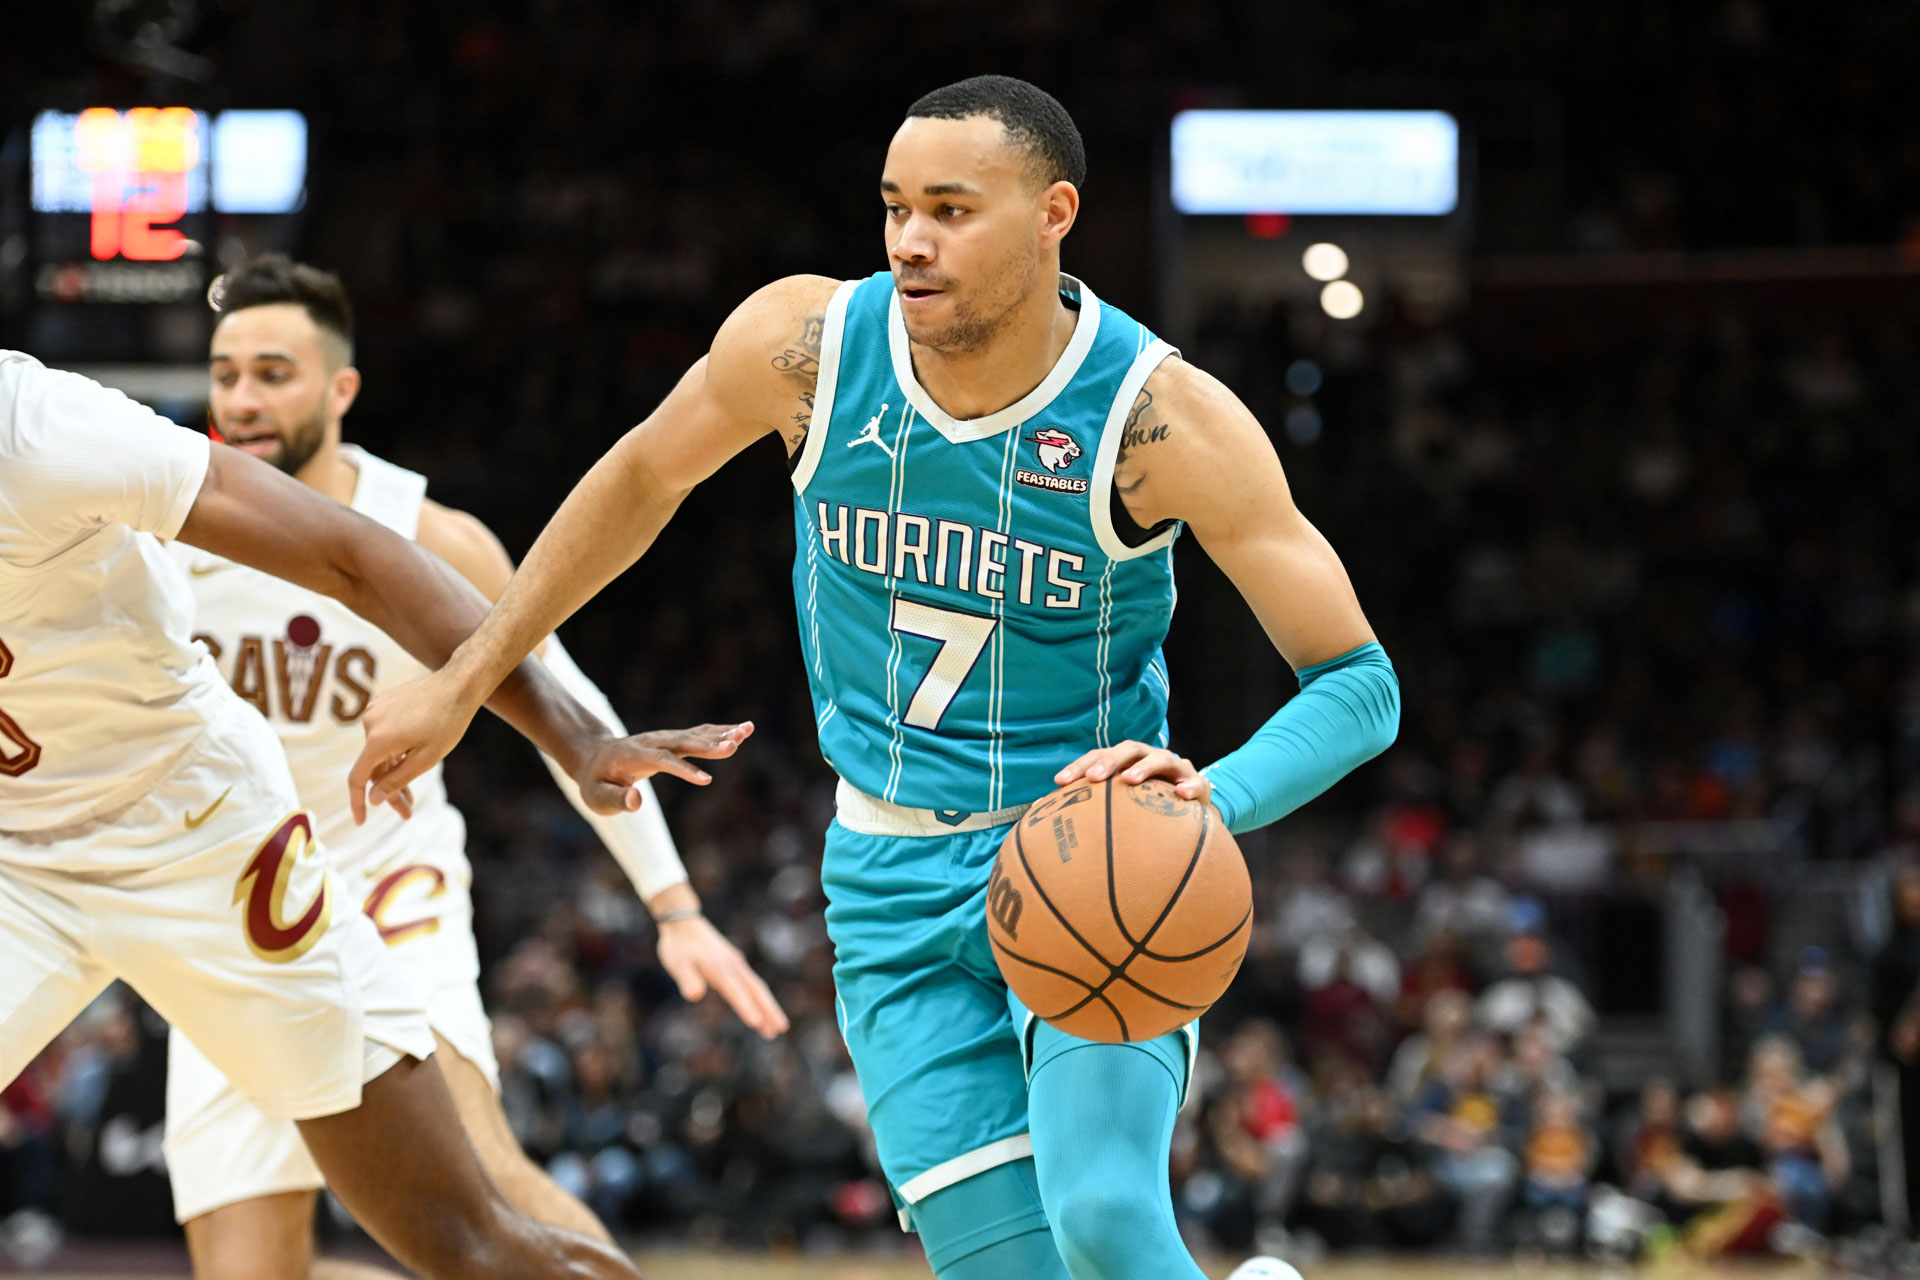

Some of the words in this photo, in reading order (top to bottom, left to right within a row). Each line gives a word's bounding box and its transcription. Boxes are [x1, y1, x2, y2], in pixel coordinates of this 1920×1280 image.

[1016, 470, 1088, 492] FEASTABLES
[817, 501, 1091, 610] HORNETS
[891, 596, 1000, 731] 7
